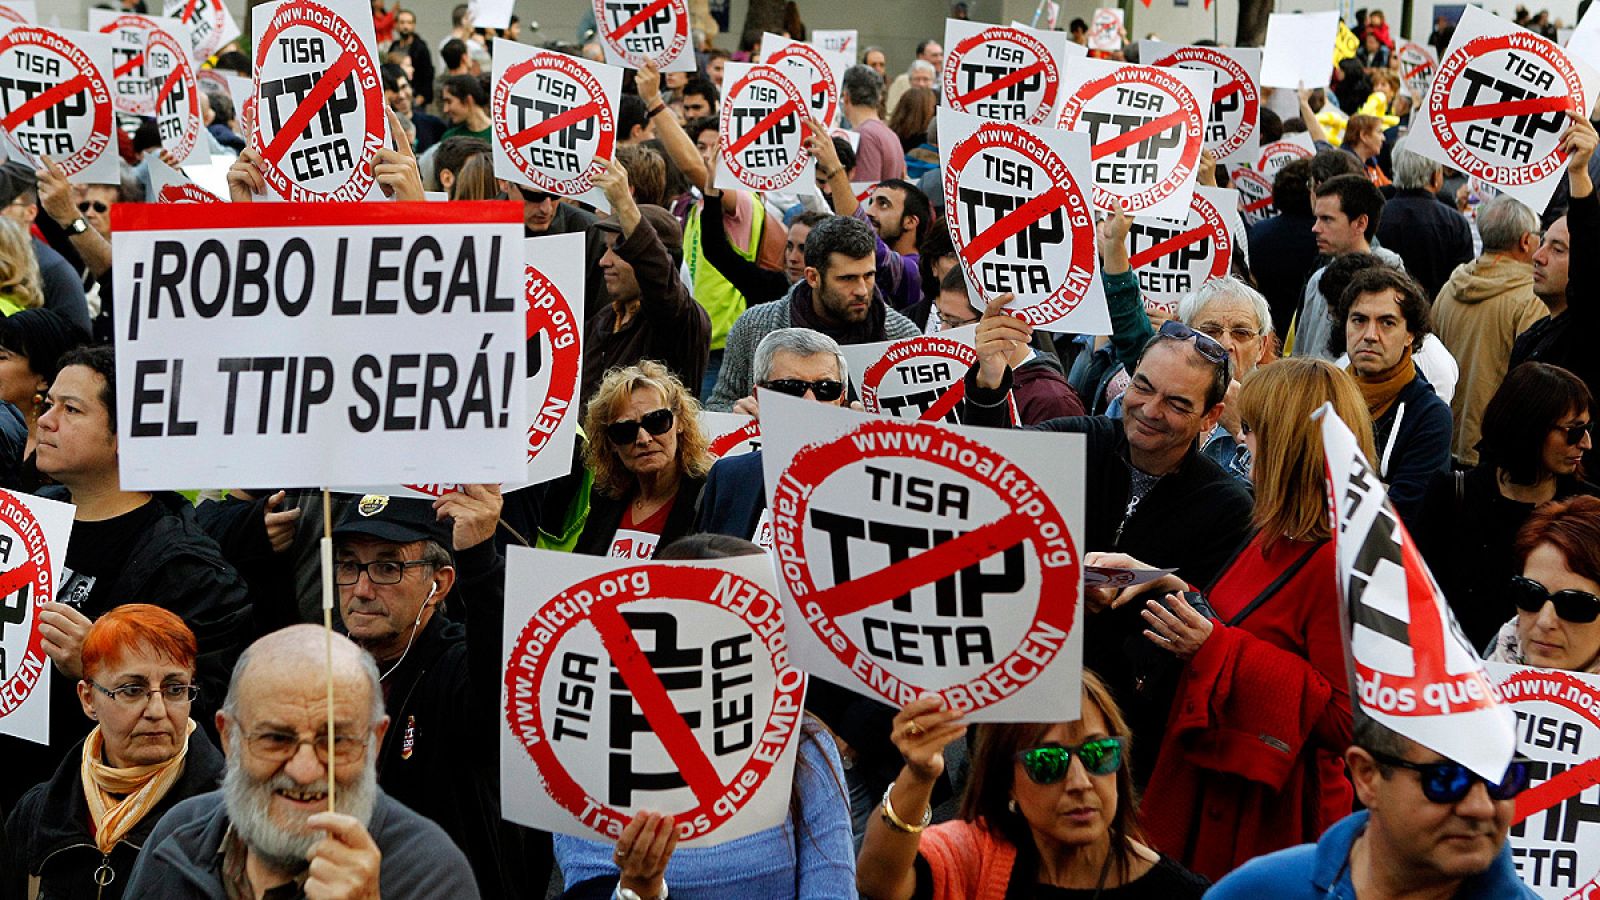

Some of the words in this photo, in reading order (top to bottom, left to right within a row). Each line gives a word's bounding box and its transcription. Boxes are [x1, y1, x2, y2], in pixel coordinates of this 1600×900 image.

[605, 3, 671, 34] TTIP
[15, 50, 60, 77] TISA
[272, 8, 377, 90] www.noalttip.org
[279, 38, 325, 63] TISA
[624, 36, 664, 52] CETA
[982, 31, 1057, 83] www.noalttip.org
[986, 44, 1024, 64] TISA
[532, 57, 613, 132] www.noalttip.org
[536, 73, 577, 102] TISA
[749, 85, 777, 104] TISA
[961, 63, 1041, 101] TTIP
[1431, 47, 1474, 112] Tratados
[1505, 51, 1555, 92] TISA
[0, 77, 87, 129] TTIP
[261, 69, 358, 140] TTIP
[510, 95, 595, 151] TTIP
[1113, 70, 1202, 138] www.noalttip.org
[1116, 87, 1164, 113] TISA
[1462, 67, 1567, 139] TTIP
[732, 107, 796, 146] TTIP
[1081, 111, 1182, 161] TTIP
[1432, 114, 1454, 142] que
[1465, 124, 1534, 164] CETA
[291, 138, 353, 182] CETA
[530, 147, 580, 174] CETA
[744, 147, 789, 169] CETA
[976, 129, 1089, 228] www.noalttip.org
[982, 152, 1034, 191] TISA
[1096, 163, 1158, 185] CETA
[1447, 145, 1562, 186] EMPOBRECEN
[1092, 163, 1191, 212] MPOBRECEN
[958, 186, 1065, 261] TTIP
[128, 237, 315, 341] ¡ROBO
[331, 234, 515, 316] LEGAL
[982, 261, 1053, 294] CETA
[1139, 270, 1192, 293] CETA
[130, 358, 198, 438] EL
[217, 355, 334, 436] TTIP
[348, 332, 515, 433] SERÁ!
[896, 362, 952, 385] TISA
[850, 431, 1072, 568] www.noalttip.org
[864, 465, 969, 521] TISA
[773, 470, 813, 598] Tratados
[805, 600, 849, 653] que
[810, 508, 1025, 619] TTIP
[515, 570, 650, 747] www.noalttip.org
[862, 616, 994, 668] CETA
[551, 651, 599, 742] TISA
[608, 611, 703, 808] TTIP
[710, 632, 753, 757] CETA
[1424, 678, 1486, 715] que
[582, 794, 711, 840] Traos
[713, 767, 760, 816] que
[1511, 847, 1578, 889] ETA
